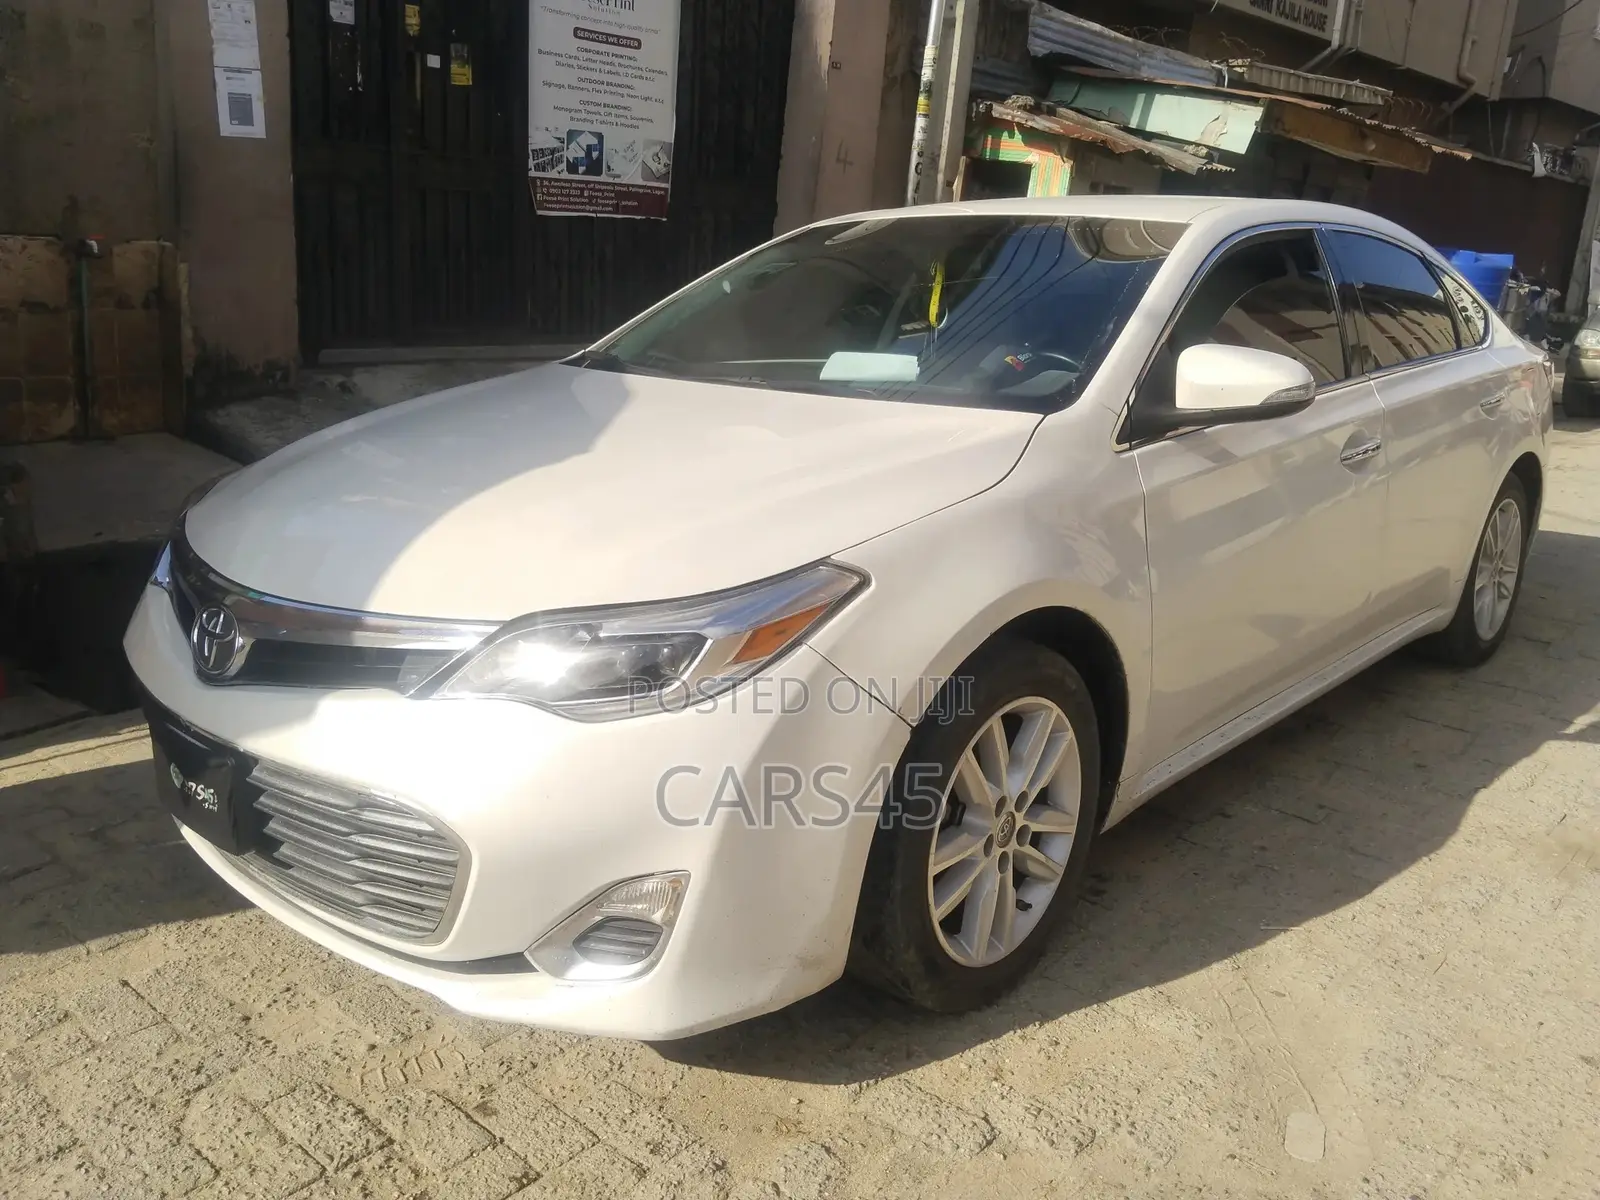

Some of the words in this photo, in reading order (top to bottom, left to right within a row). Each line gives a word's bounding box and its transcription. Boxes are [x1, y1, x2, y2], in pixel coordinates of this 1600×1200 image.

[1303, 6, 1328, 33] HOUSE
[576, 30, 607, 42] SERVICES
[607, 36, 618, 44] WE
[619, 38, 639, 47] OFFER
[538, 48, 563, 59] Business
[576, 46, 611, 58] CORPORATE
[577, 77, 605, 86] OUTDOOR
[579, 99, 602, 108] CUSTOM
[553, 105, 583, 115] Monogram
[569, 116, 594, 126] Branding
[620, 122, 640, 131] Hoodies
